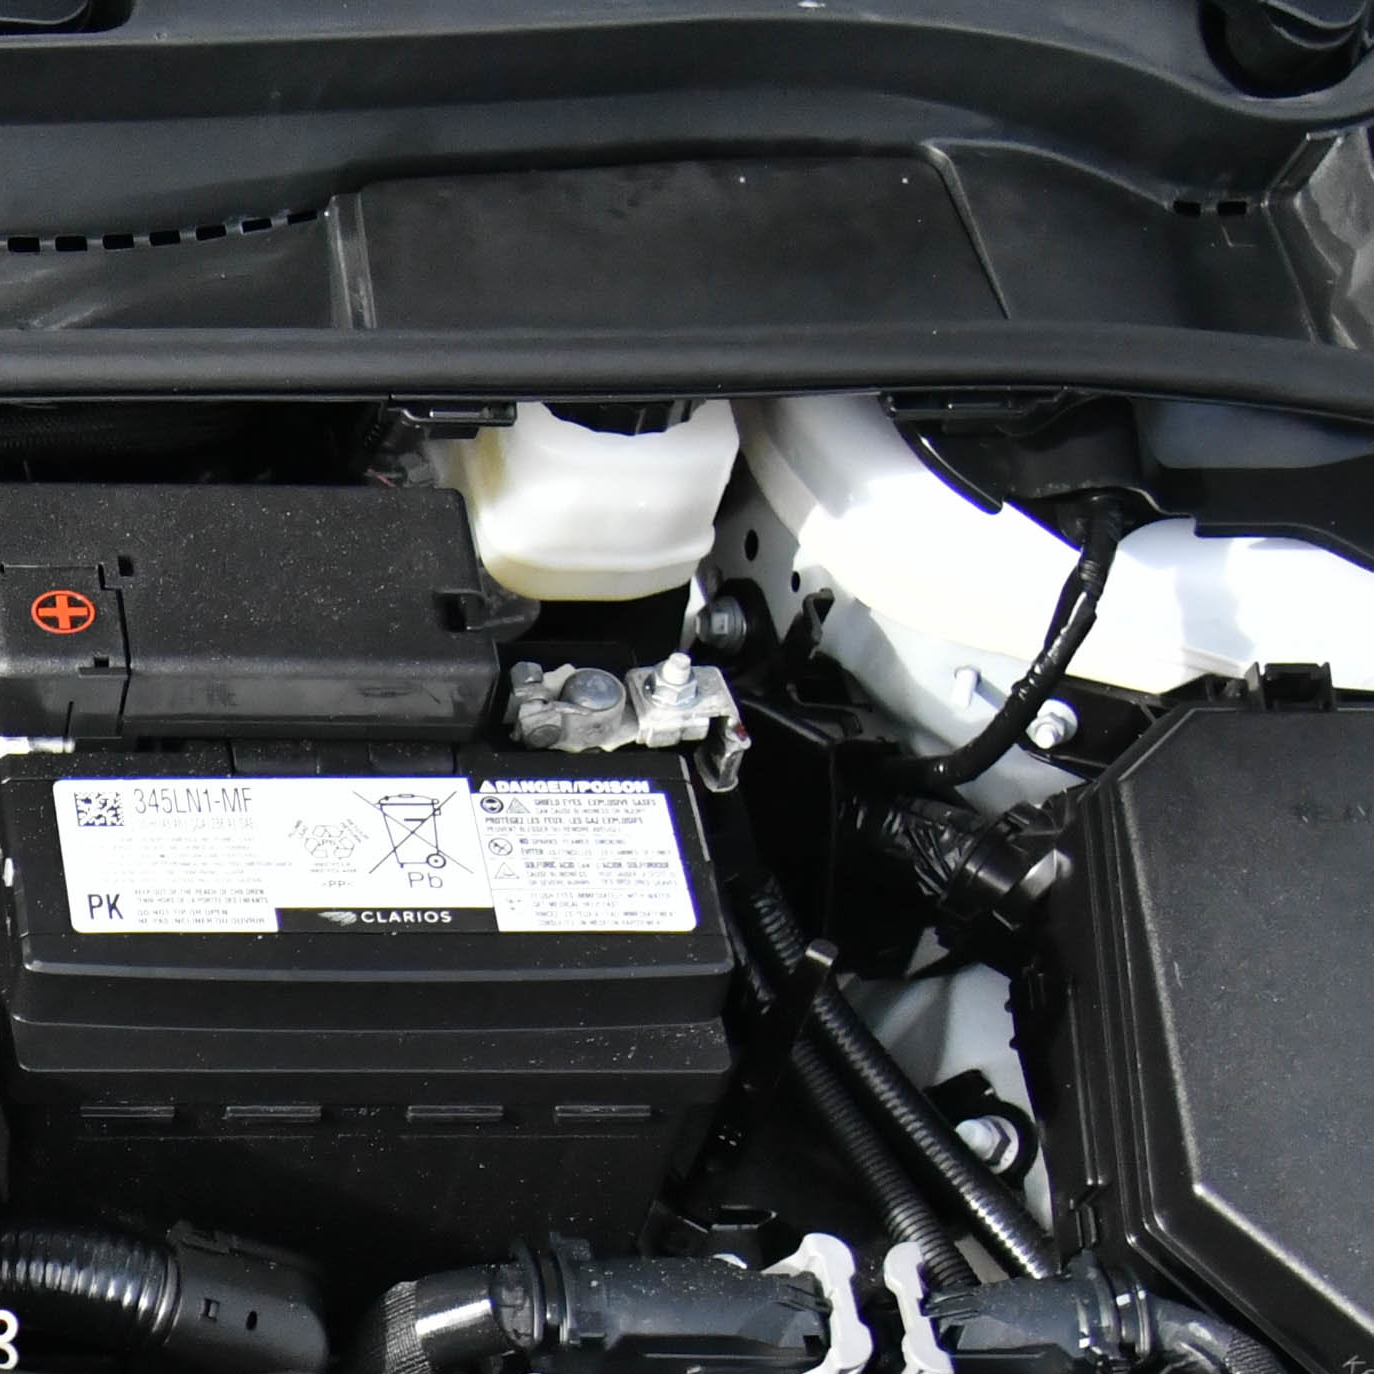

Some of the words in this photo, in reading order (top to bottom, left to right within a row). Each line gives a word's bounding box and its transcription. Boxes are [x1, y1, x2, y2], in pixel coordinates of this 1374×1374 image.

[495, 780, 650, 794] DANGER/POISON
[133, 787, 253, 814] 345LN1-MF
[407, 871, 443, 889] Pb
[87, 892, 124, 921] PK
[361, 911, 452, 923] CLARIOS
